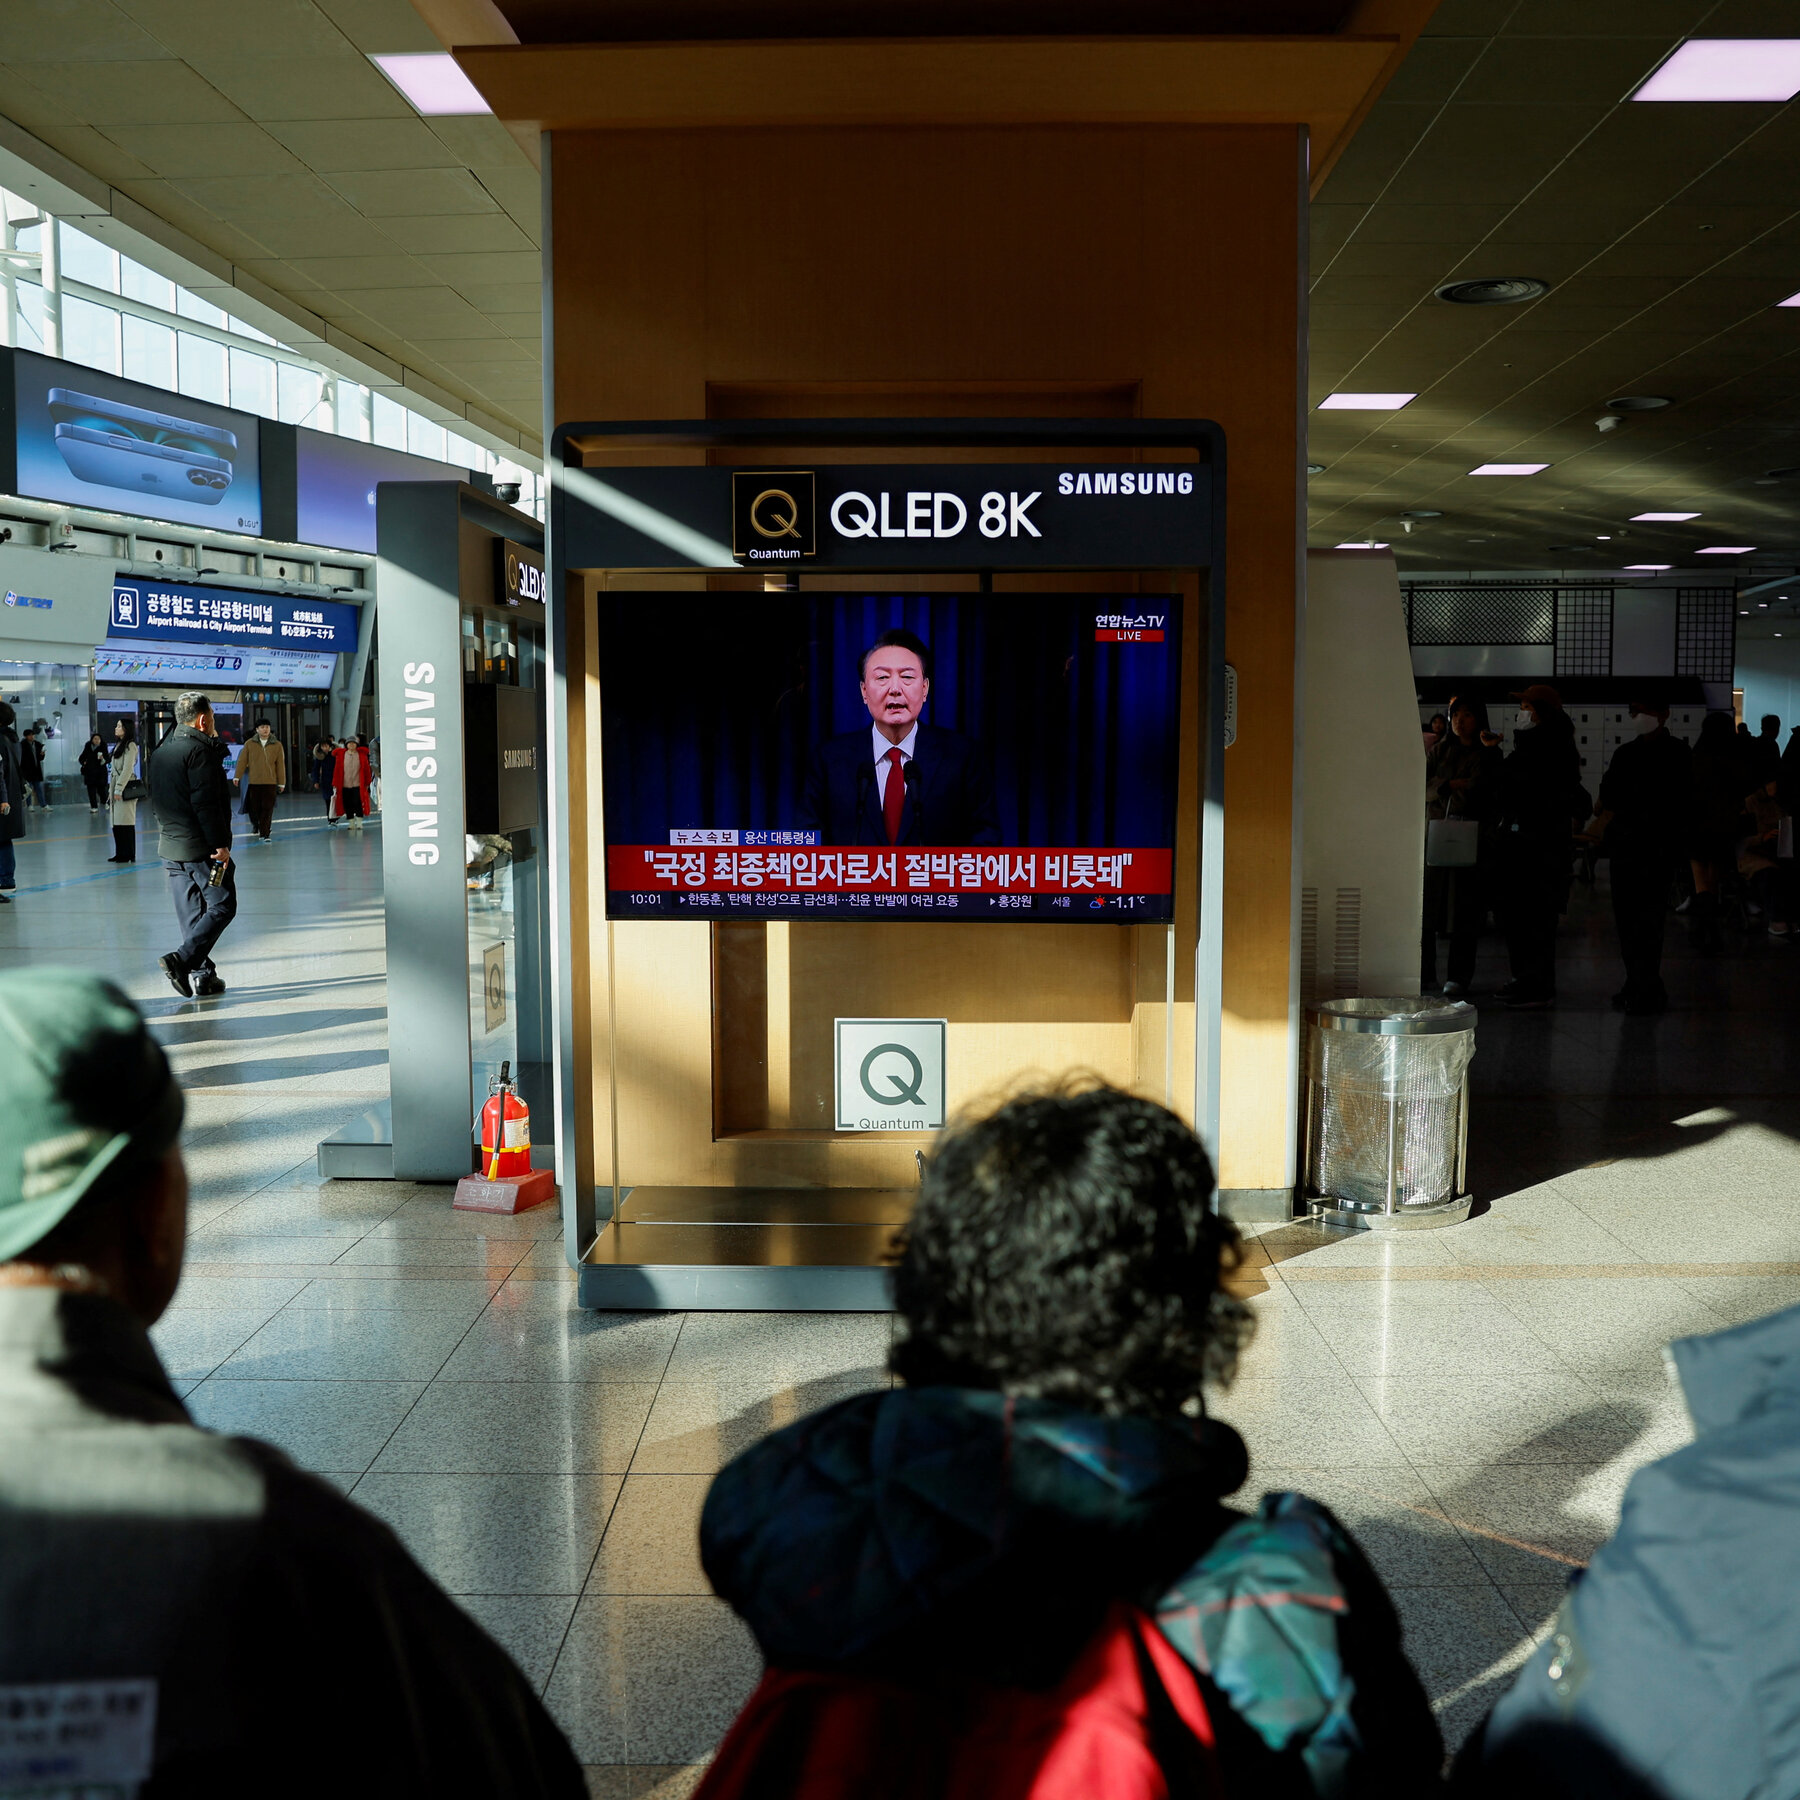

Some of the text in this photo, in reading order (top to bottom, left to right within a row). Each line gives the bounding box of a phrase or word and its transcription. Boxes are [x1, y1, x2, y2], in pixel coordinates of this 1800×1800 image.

[1058, 472, 1193, 495] SAMSUNG
[750, 489, 802, 538] Q
[830, 491, 1043, 538] QLED 8K
[749, 547, 800, 560] Quantum
[147, 593, 273, 623] 공항철도 도심공항터미널
[147, 615, 273, 635] Airport Railroad & City Airport Terminal
[1095, 614, 1165, 628] 연합뉴스TV
[1117, 631, 1141, 641] LIVE
[403, 662, 440, 866] SAMSUNG
[504, 749, 532, 769] SAMSUNG
[676, 831, 733, 844] 뉴스속보
[744, 831, 815, 845] 용산 대통령실
[644, 850, 1133, 889] "국정 최종책임자로서 절박함에서 비롯돼"
[630, 893, 661, 905] 10:01
[688, 893, 725, 907] 한동훈,
[727, 893, 751, 906] '탄핵
[755, 893, 801, 907] 찬성'으로
[874, 893, 908, 907] 반발에
[911, 894, 933, 908] 여권
[936, 894, 959, 908] 요동
[998, 894, 1032, 908] 홍장원
[1052, 896, 1071, 908] 서울
[859, 1043, 927, 1106] Q
[859, 1118, 924, 1130] Quantum
